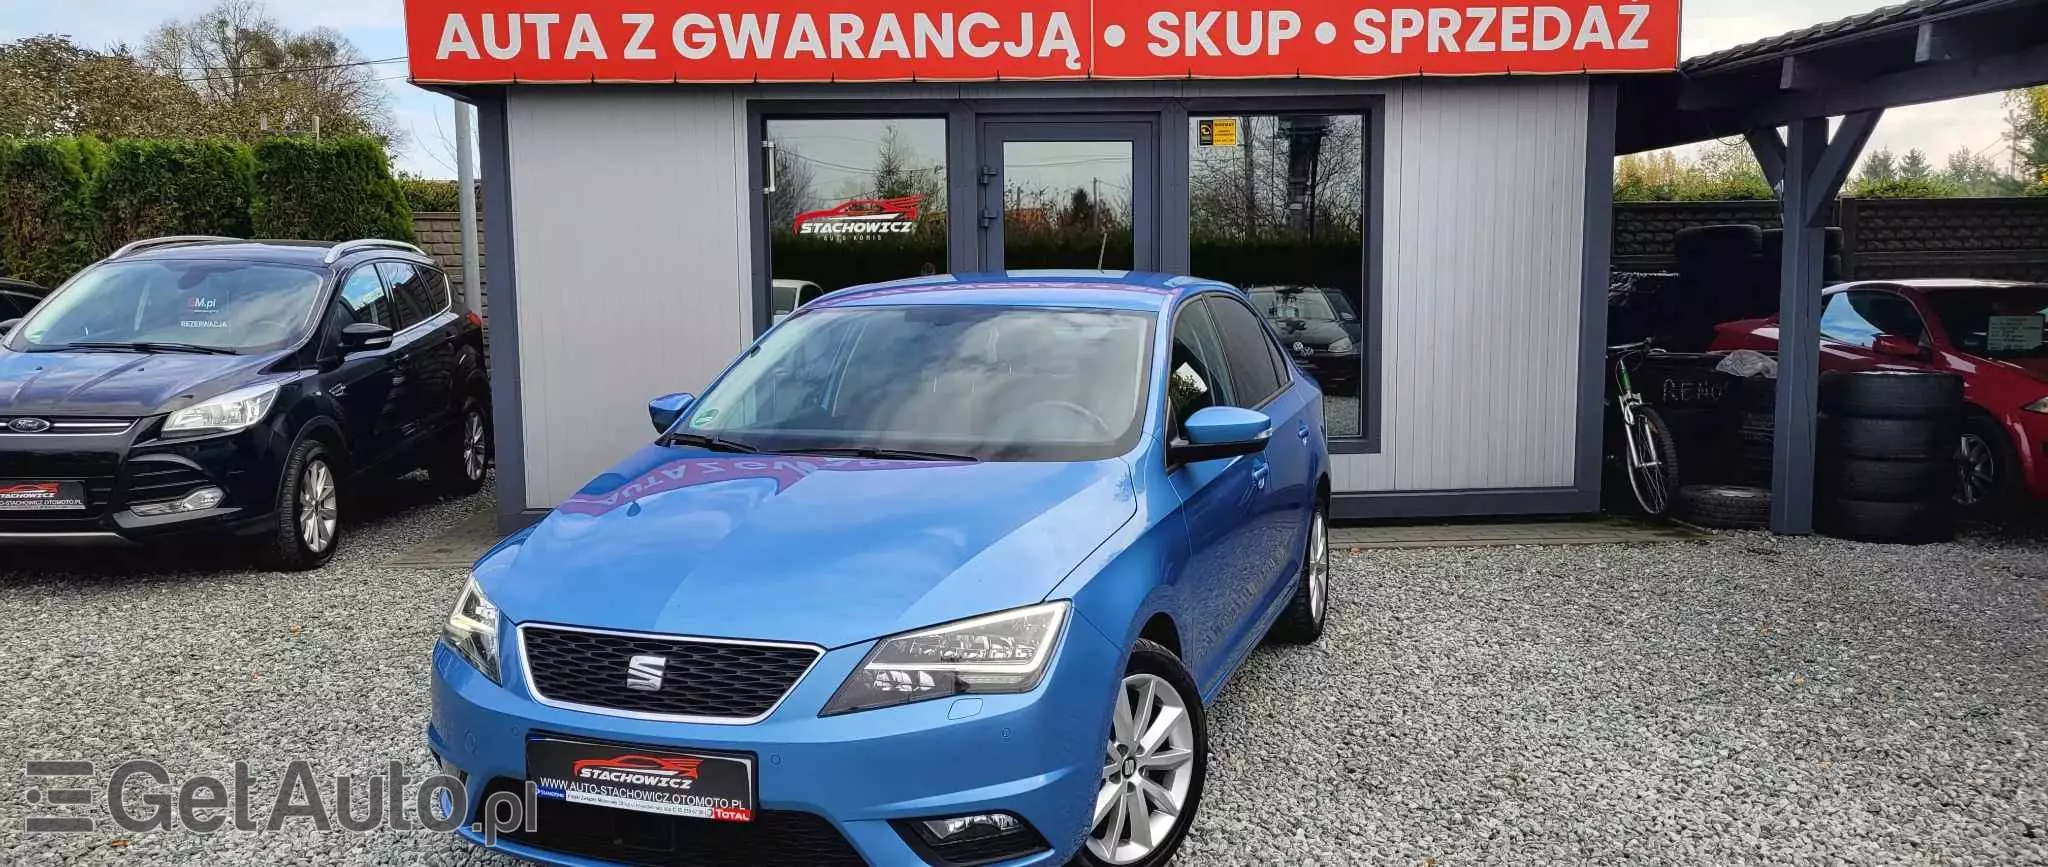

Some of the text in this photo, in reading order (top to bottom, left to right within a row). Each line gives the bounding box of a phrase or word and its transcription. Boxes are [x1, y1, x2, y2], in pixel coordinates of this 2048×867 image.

[435, 11, 1082, 70] AUTA Z GWARANCJĄ
[1147, 10, 1302, 57] SKUP
[1353, 0, 1651, 54] SPRZEDAŻ
[799, 221, 913, 234] STACHOWICZ
[180, 320, 228, 328] REZERWACJA
[540, 777, 745, 810] WWW.AUTO-STACHOWICZ.OTOMOTO.PL
[580, 768, 693, 789] STACHOWICZ
